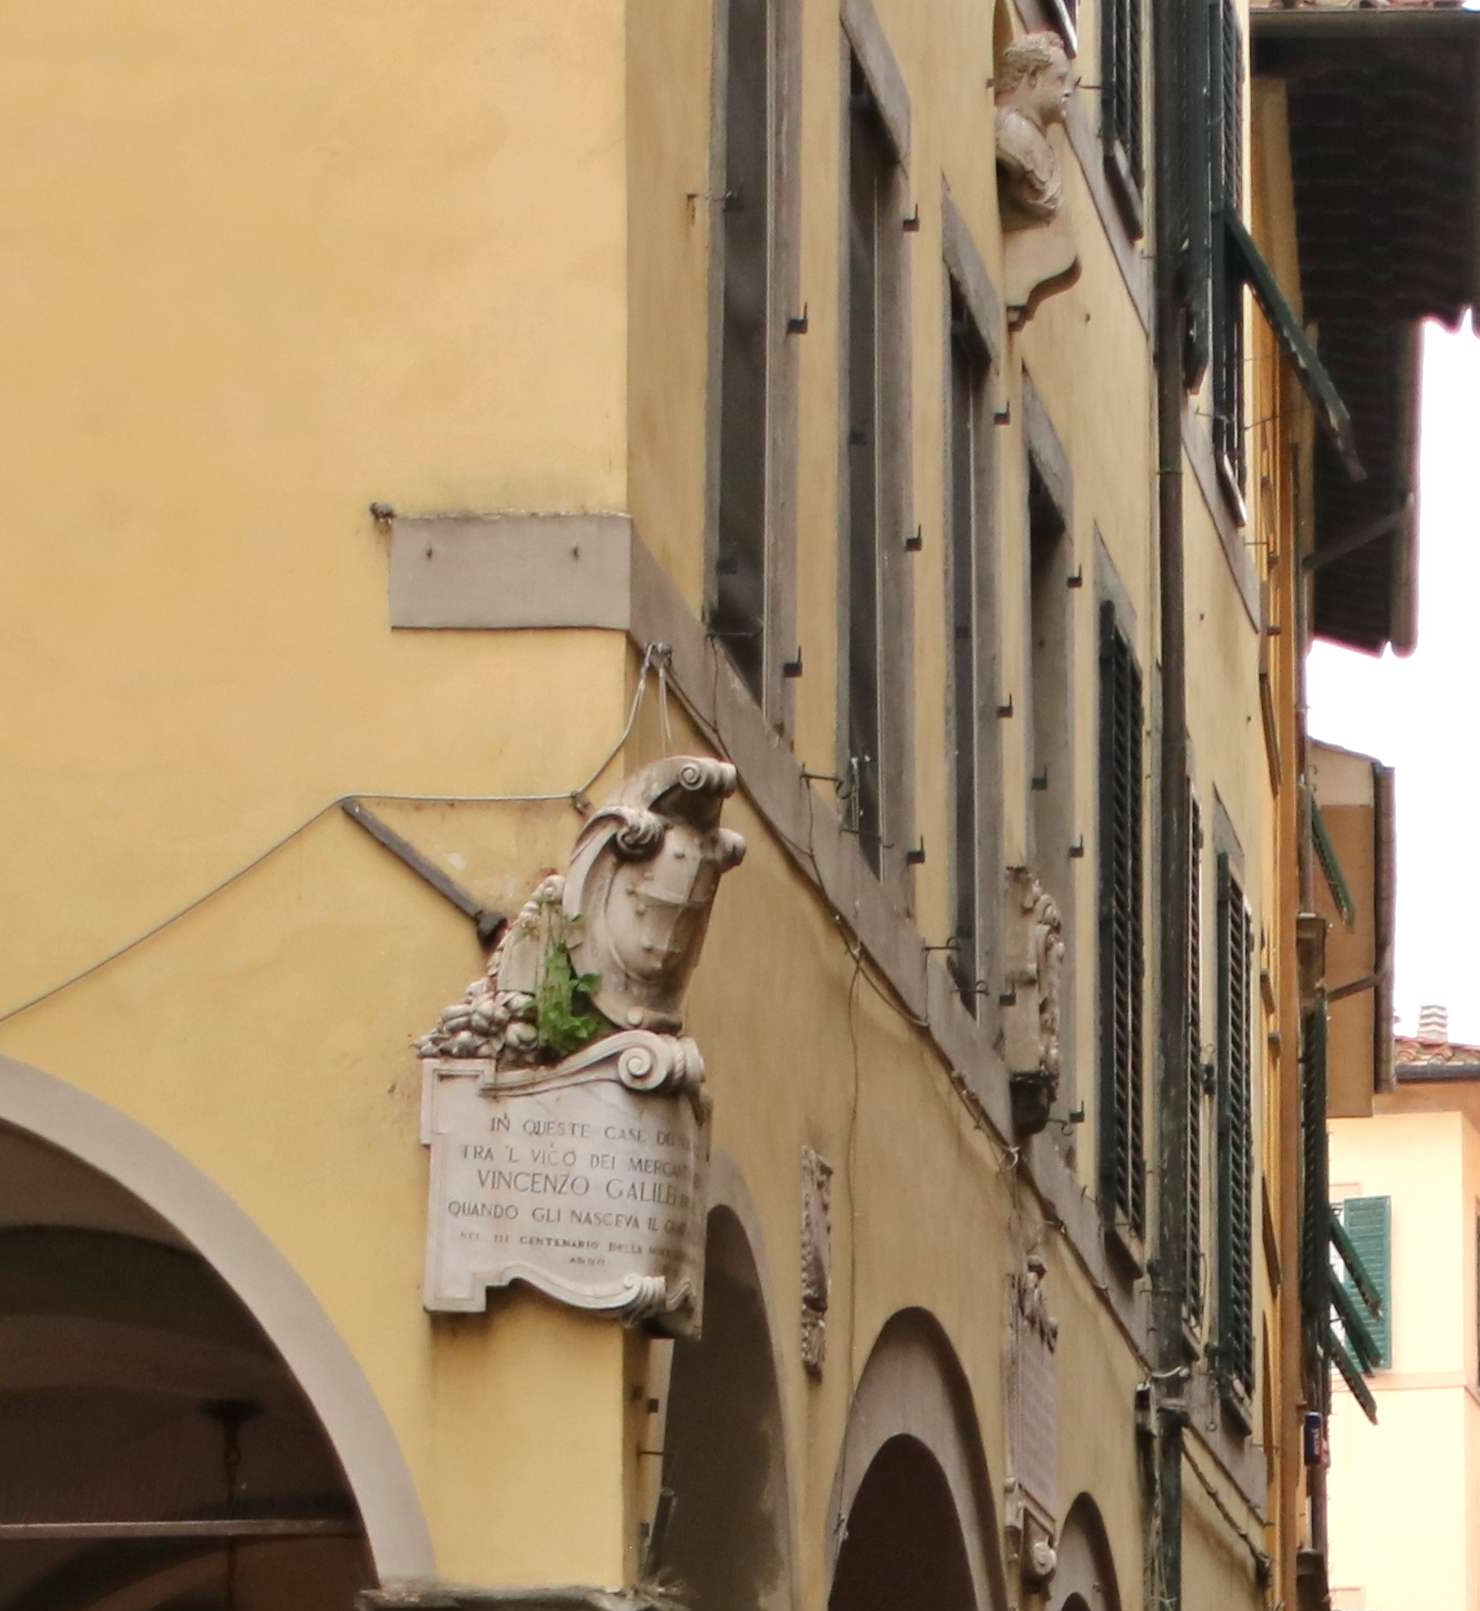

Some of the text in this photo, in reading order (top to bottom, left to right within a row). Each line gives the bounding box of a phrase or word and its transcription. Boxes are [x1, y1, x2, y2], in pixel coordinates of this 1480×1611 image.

[490, 1117, 510, 1133] IN
[523, 1119, 590, 1138] QUESTE
[462, 1145, 494, 1161] TRA
[531, 1148, 577, 1168] VICO
[590, 1154, 616, 1171] DEI
[477, 1169, 590, 1197] VINCENZO
[448, 1201, 519, 1219] QUANDO
[532, 1207, 561, 1224] GLI
[571, 1210, 639, 1230] NASCEVA
[648, 1217, 658, 1232] IL
[519, 1235, 600, 1249] CENTENARIO
